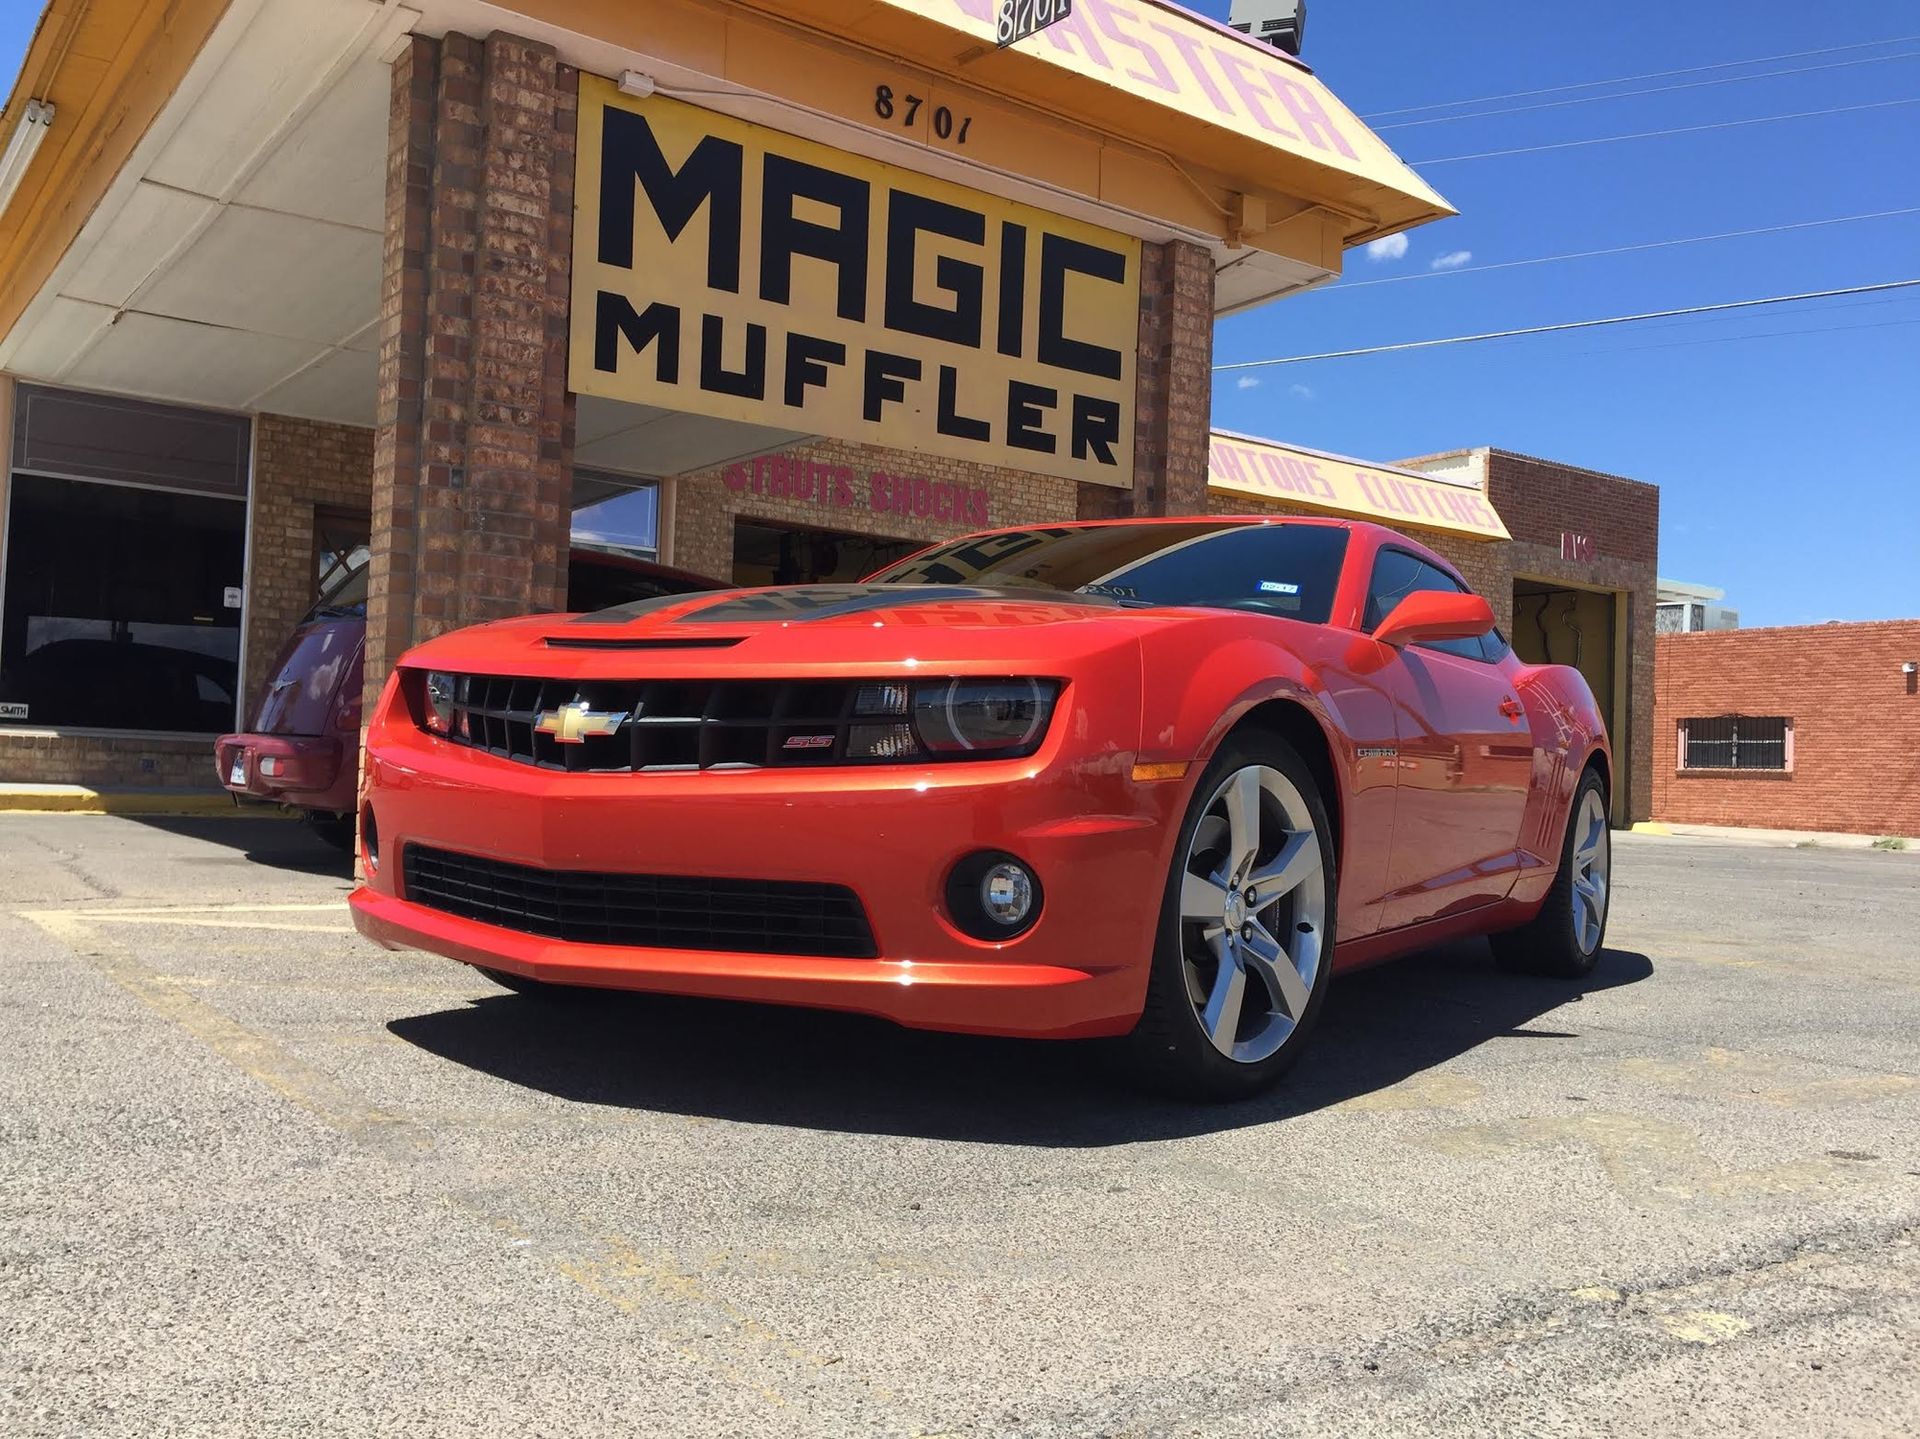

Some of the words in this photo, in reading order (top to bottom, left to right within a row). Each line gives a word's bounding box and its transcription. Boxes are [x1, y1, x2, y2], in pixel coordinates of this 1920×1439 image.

[875, 85, 971, 143] 8701
[957, 0, 1360, 161] ASTER
[598, 104, 1126, 380] MAGIC
[595, 290, 1119, 466] MUFFLER
[722, 453, 854, 508] STRUTS
[870, 471, 990, 527] SHOCKS
[1355, 473, 1499, 530] CLUTCHES
[782, 734, 836, 749] SS
